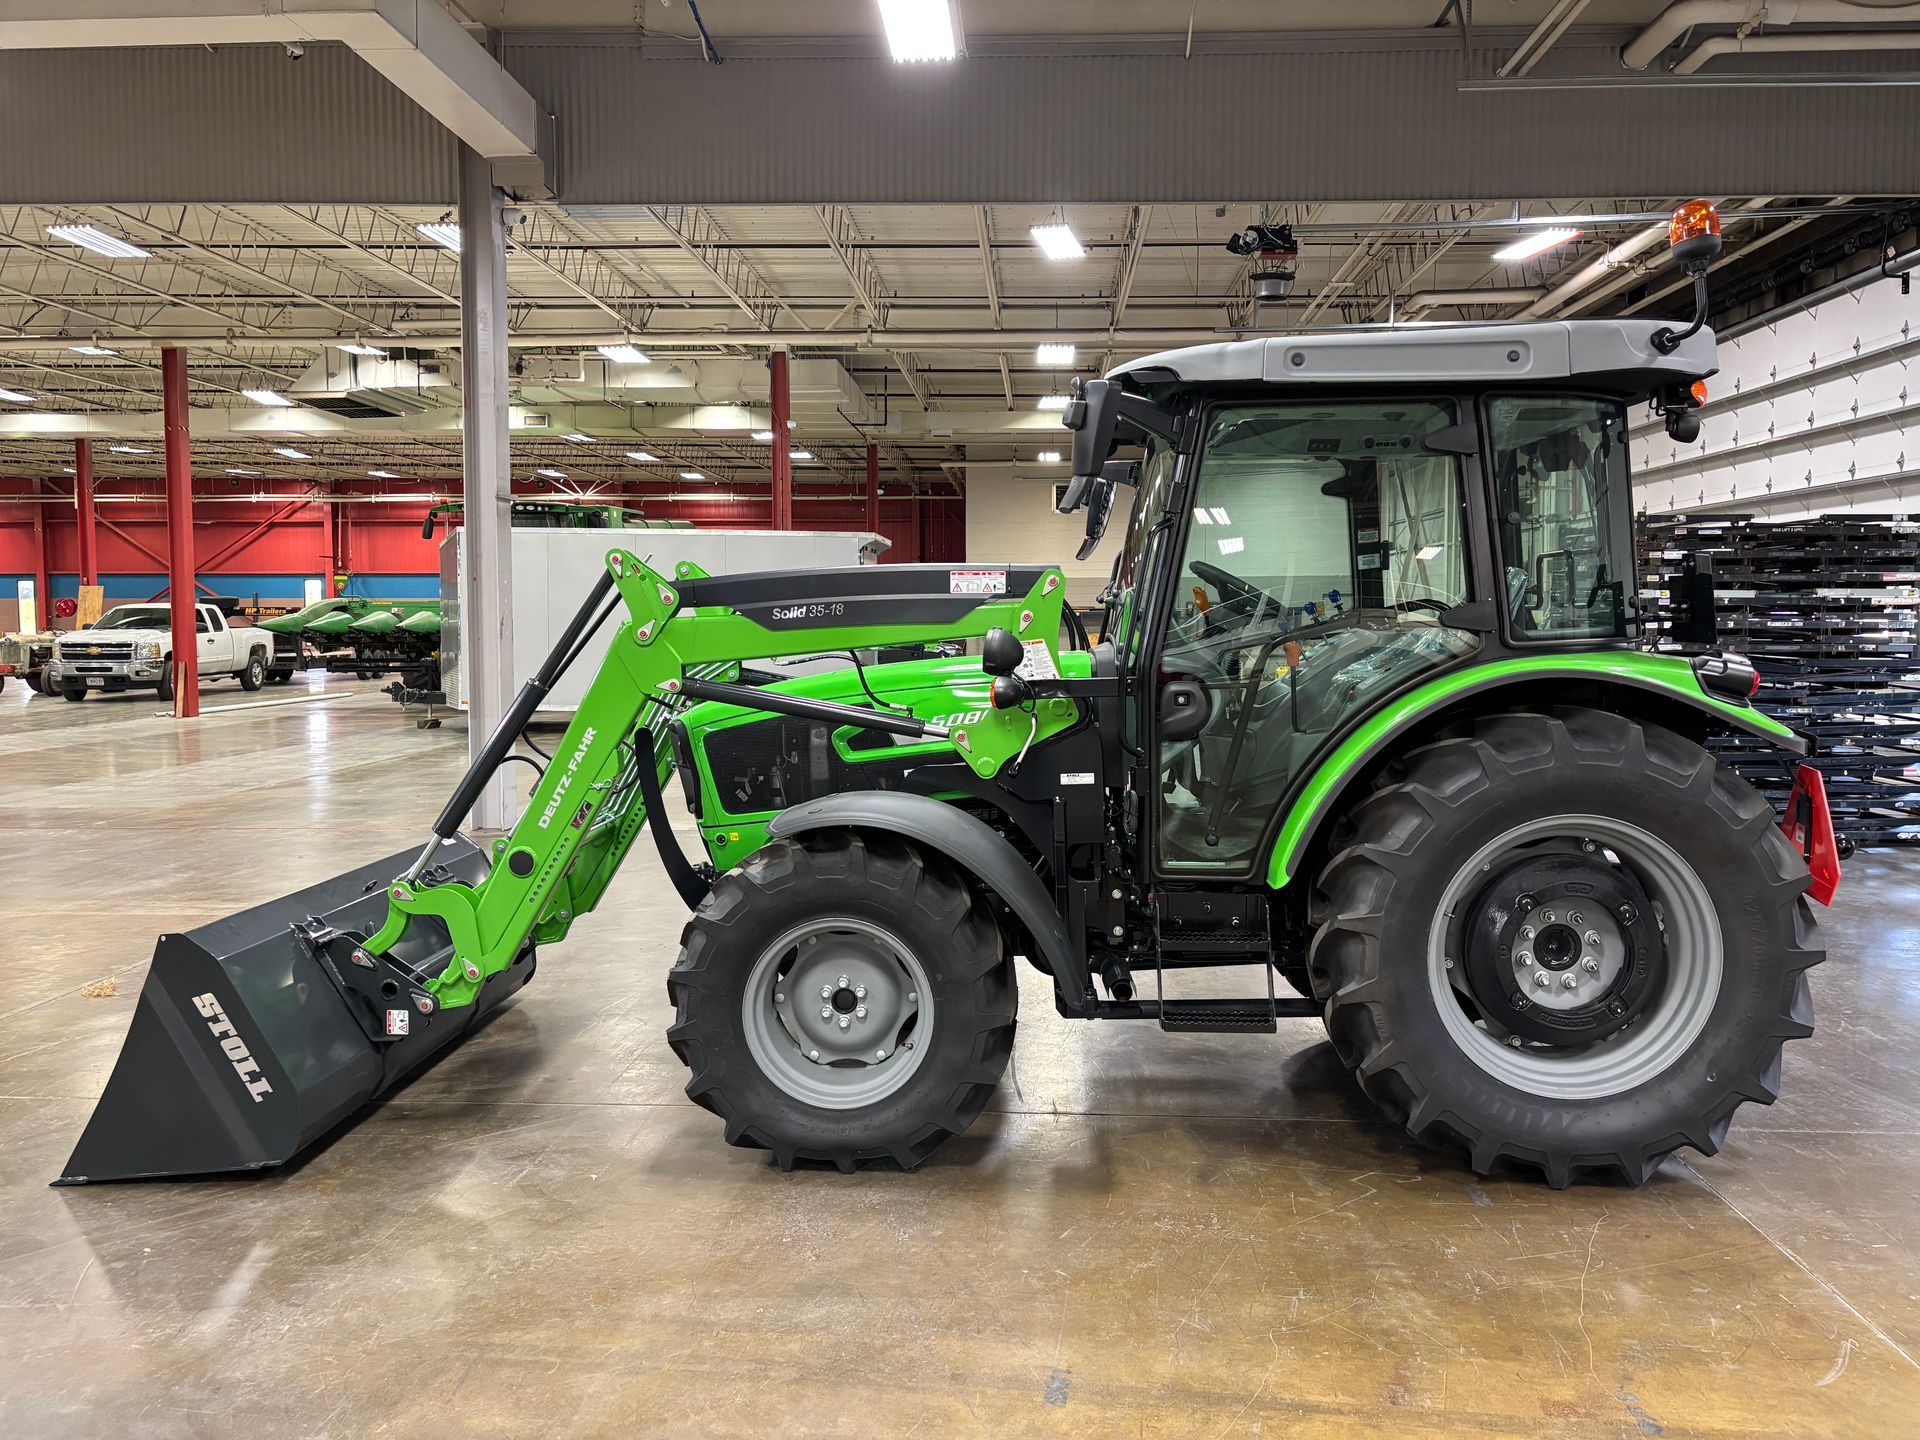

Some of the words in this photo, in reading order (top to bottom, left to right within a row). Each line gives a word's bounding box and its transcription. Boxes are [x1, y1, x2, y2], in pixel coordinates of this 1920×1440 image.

[772, 606, 806, 620] Solid
[809, 603, 844, 617] 35-18
[931, 709, 990, 728] 508
[538, 727, 597, 829] DEUTZ-FAHR
[191, 992, 274, 1104] STOLL
